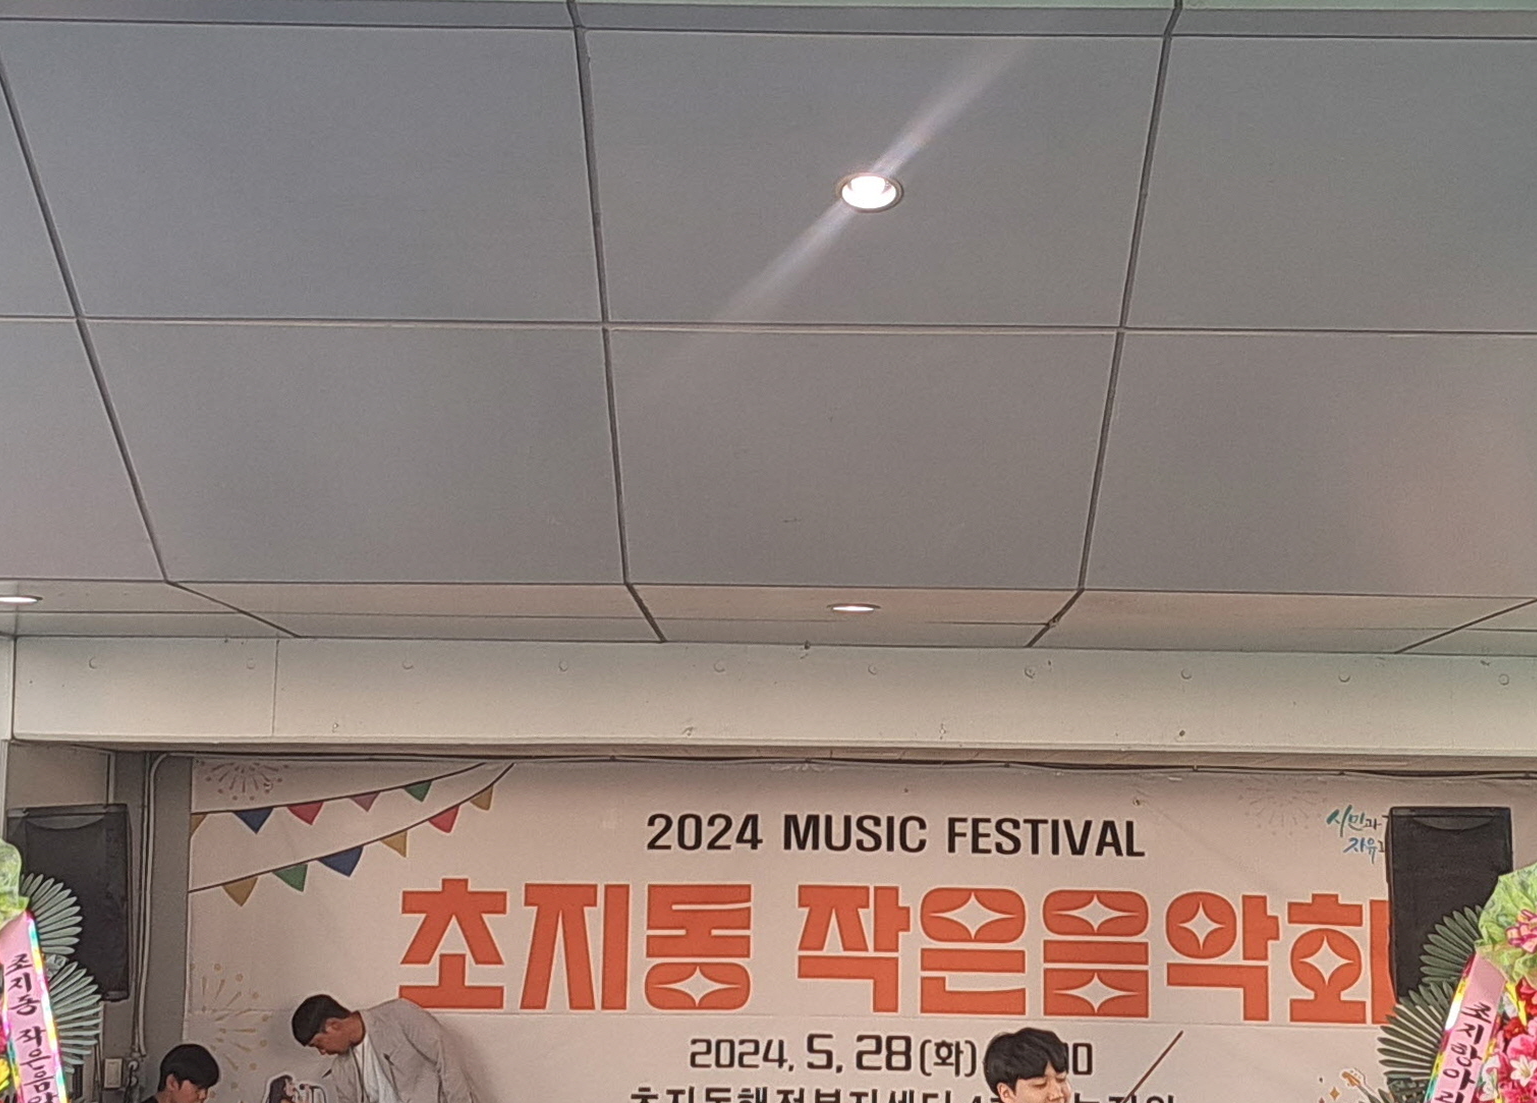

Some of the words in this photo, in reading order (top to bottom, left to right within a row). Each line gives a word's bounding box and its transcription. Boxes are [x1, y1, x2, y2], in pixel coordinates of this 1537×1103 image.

[646, 813, 763, 851] 2024
[783, 814, 927, 853] MUSIC
[947, 816, 1145, 857] FESTIVAL
[1326, 804, 1382, 837] 시민과
[398, 878, 752, 1010] 초지동
[797, 883, 1397, 1025] 작은음악회
[6, 952, 41, 1016] 초지동
